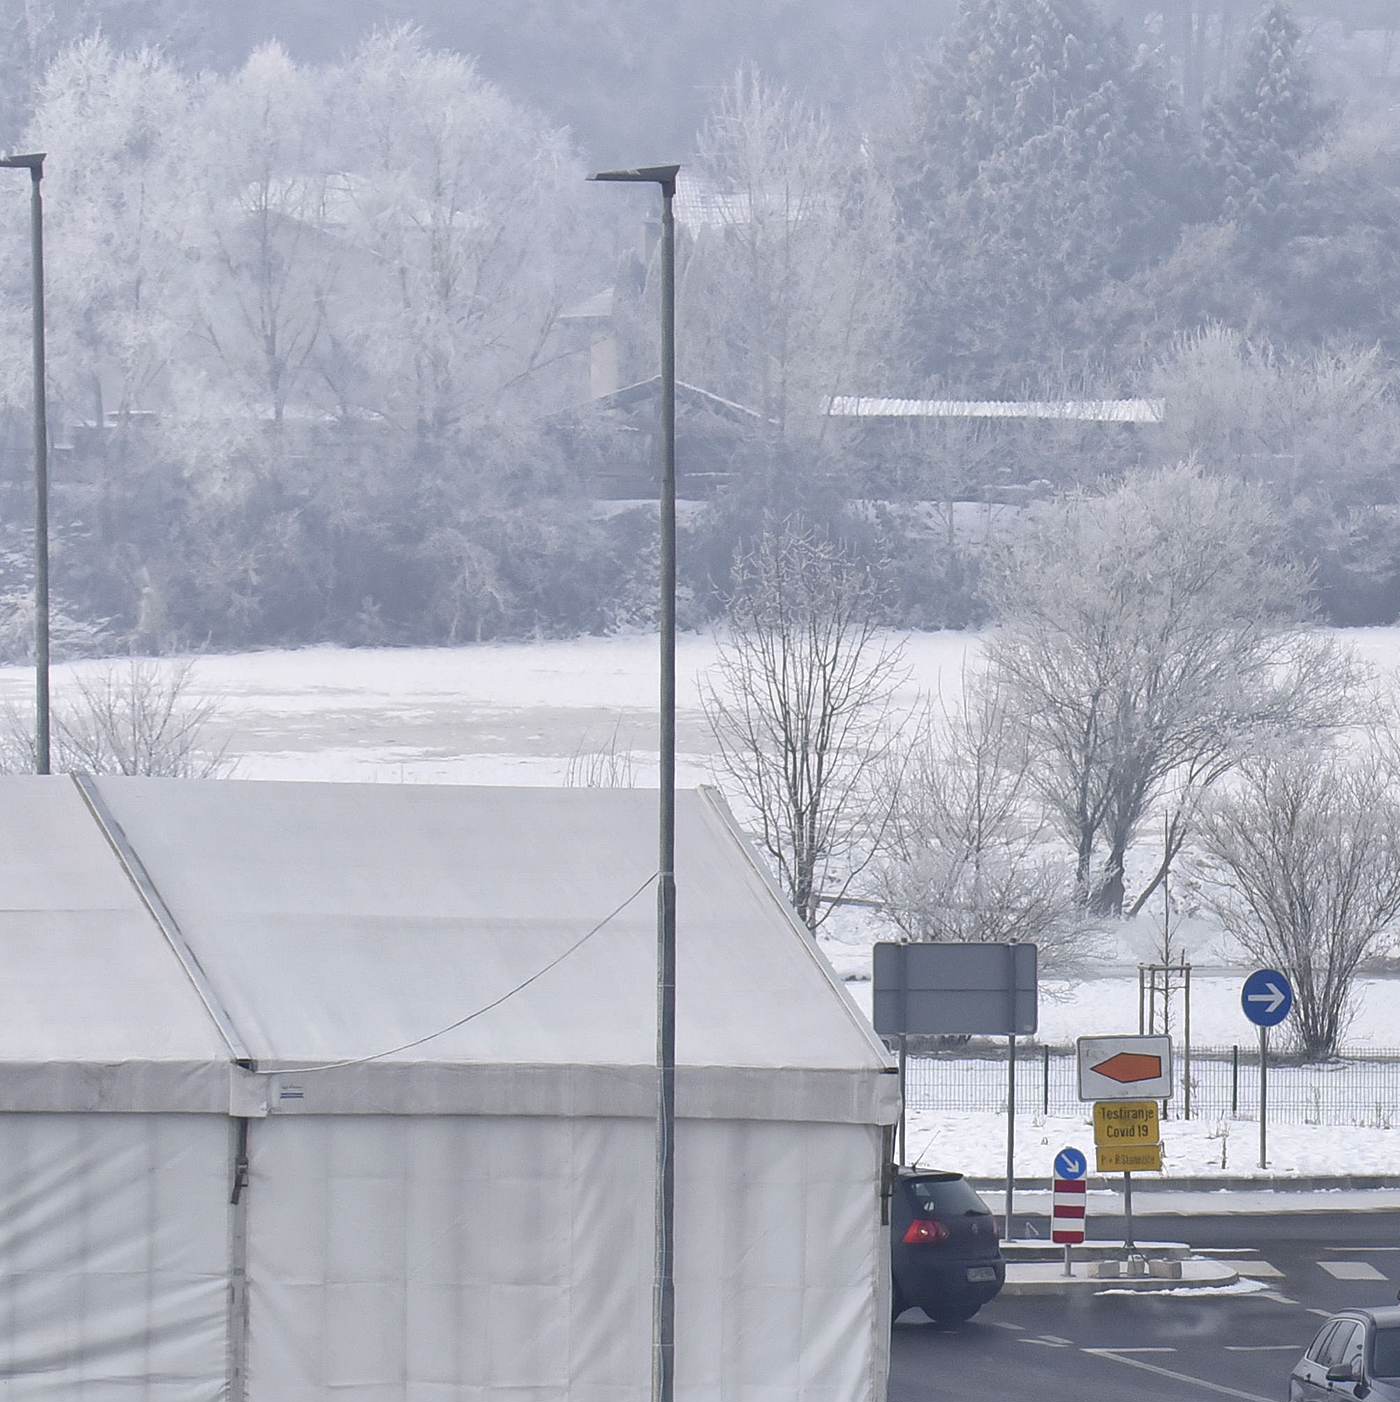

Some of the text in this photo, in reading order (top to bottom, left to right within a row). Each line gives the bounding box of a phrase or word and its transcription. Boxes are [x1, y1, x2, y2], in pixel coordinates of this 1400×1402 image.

[1101, 1107, 1154, 1122] Testiranje
[1106, 1124, 1148, 1138] Covid 19
